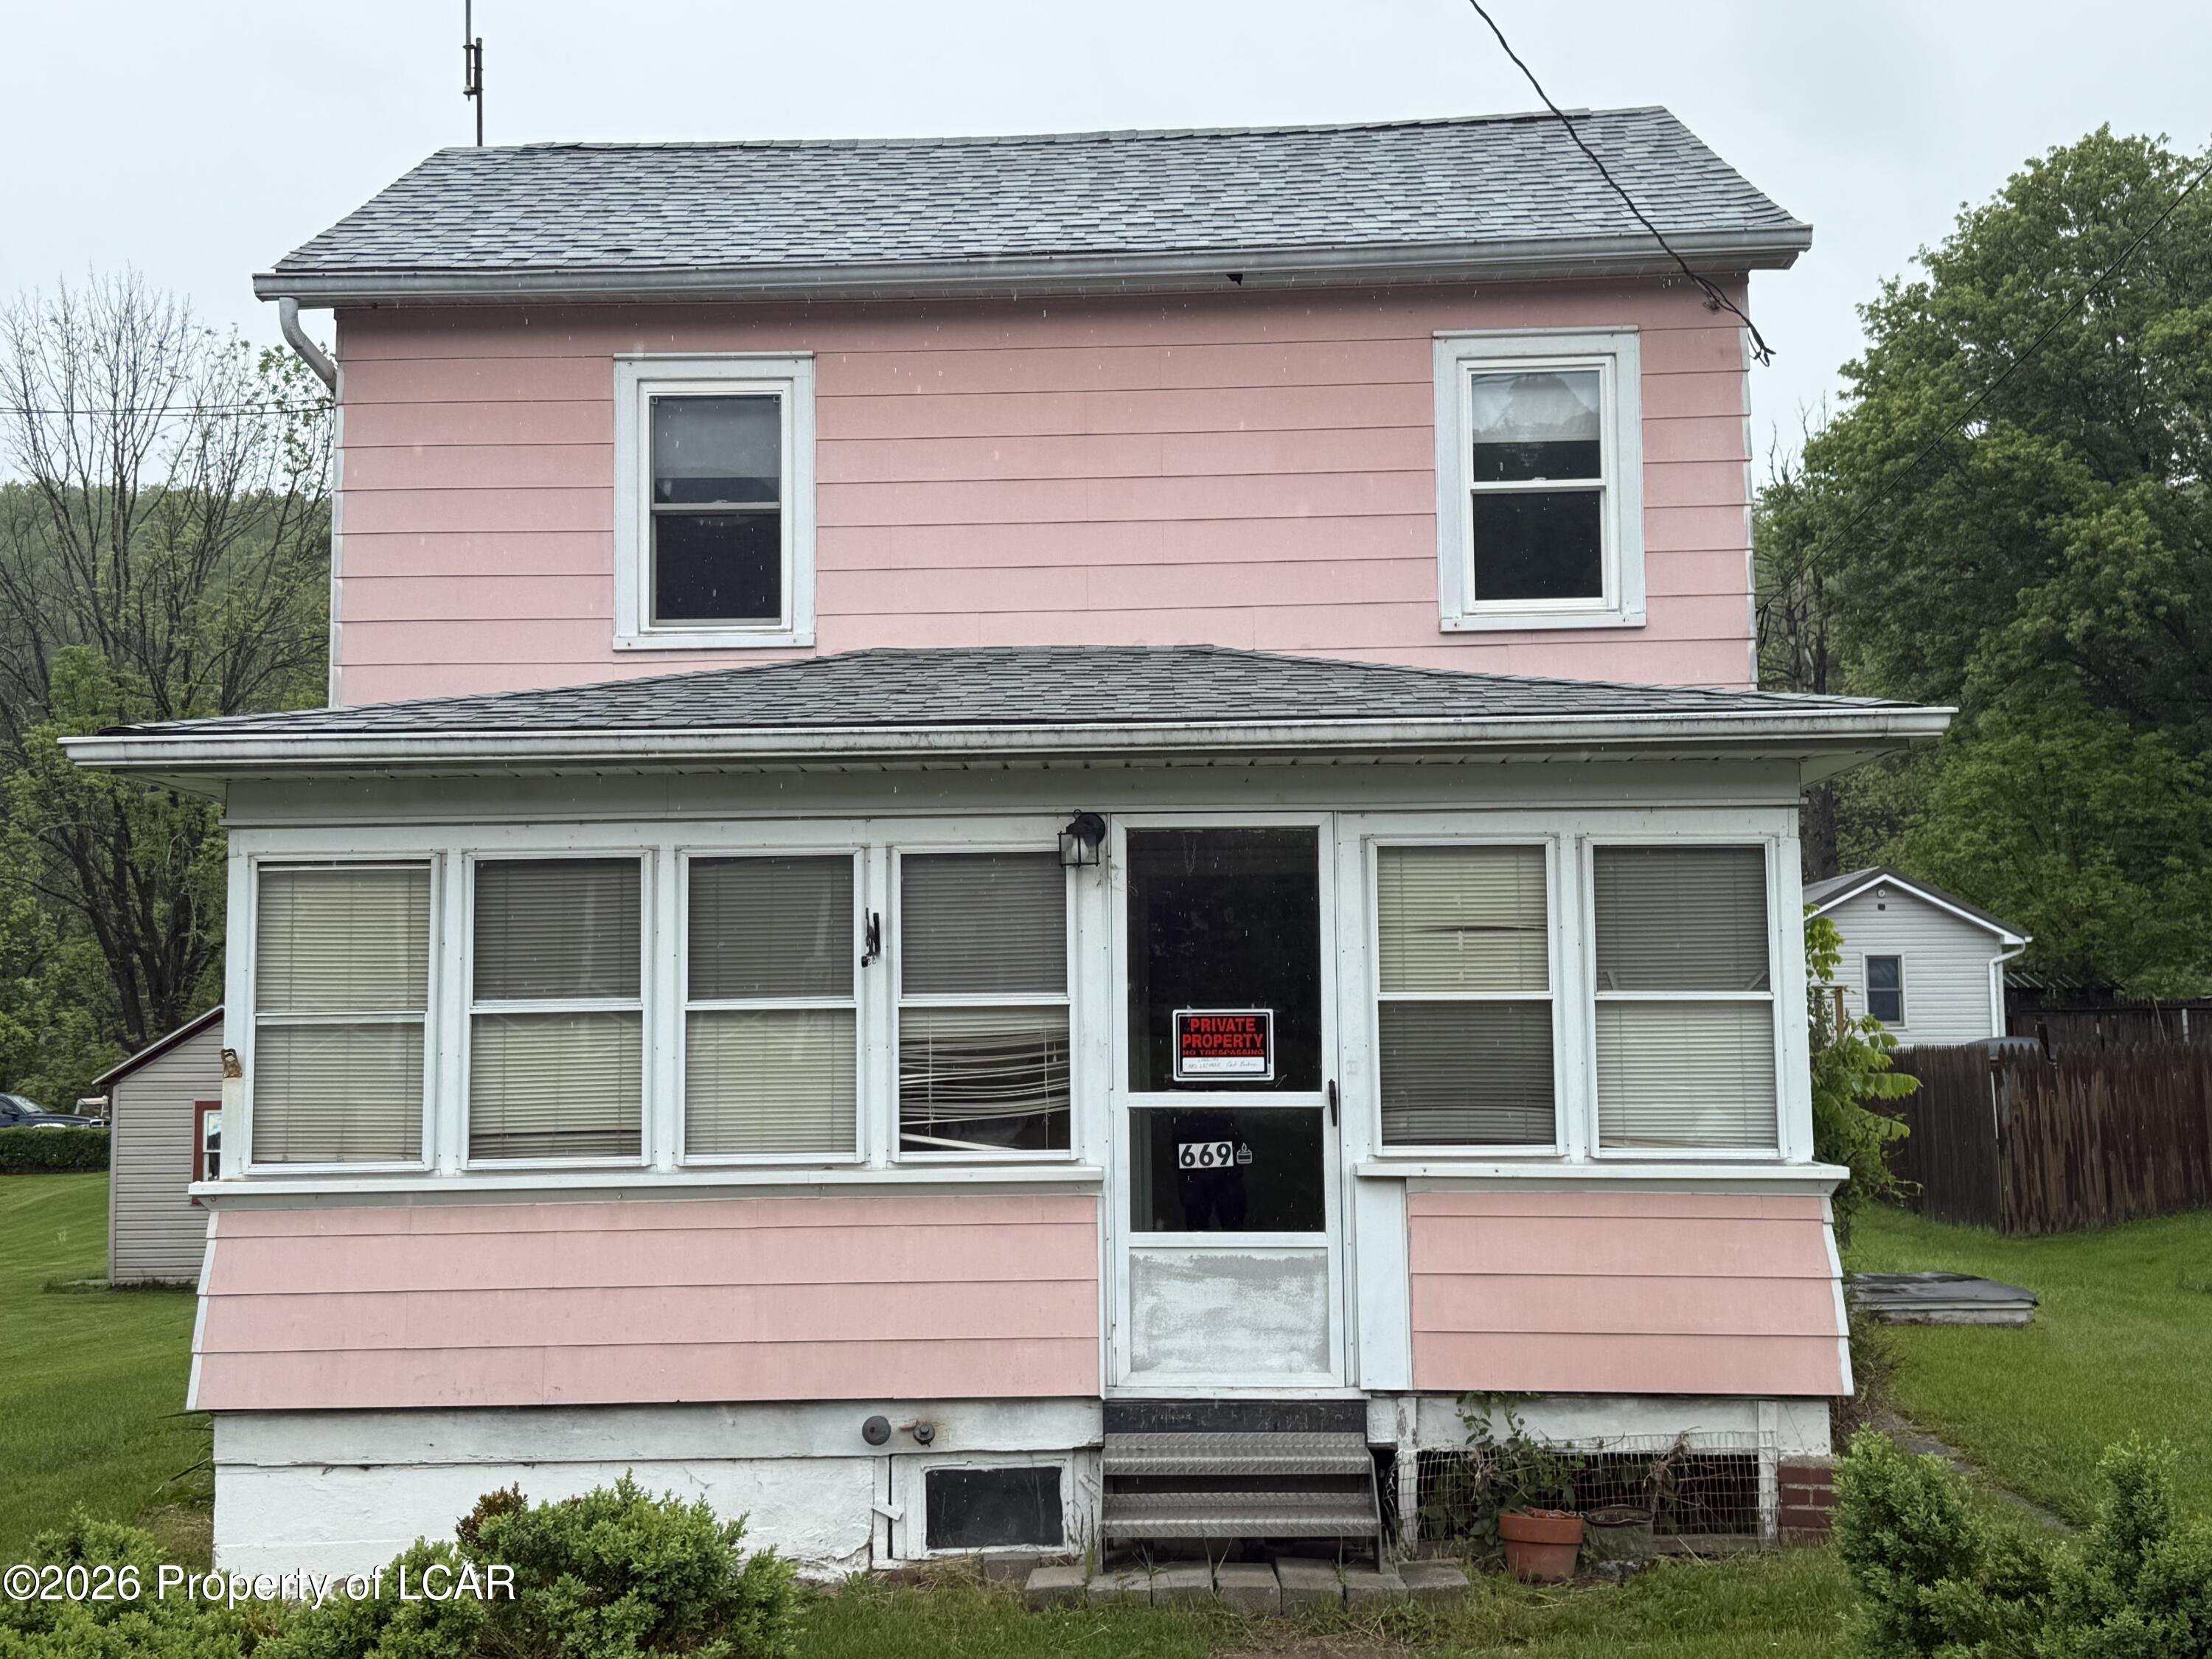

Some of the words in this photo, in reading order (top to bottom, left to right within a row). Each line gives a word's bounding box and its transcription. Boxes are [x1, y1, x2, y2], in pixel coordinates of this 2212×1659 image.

[1190, 1018, 1256, 1032] PRIVATE
[1182, 1034, 1264, 1048] PROPERTY
[1180, 1143, 1231, 1167] 669
